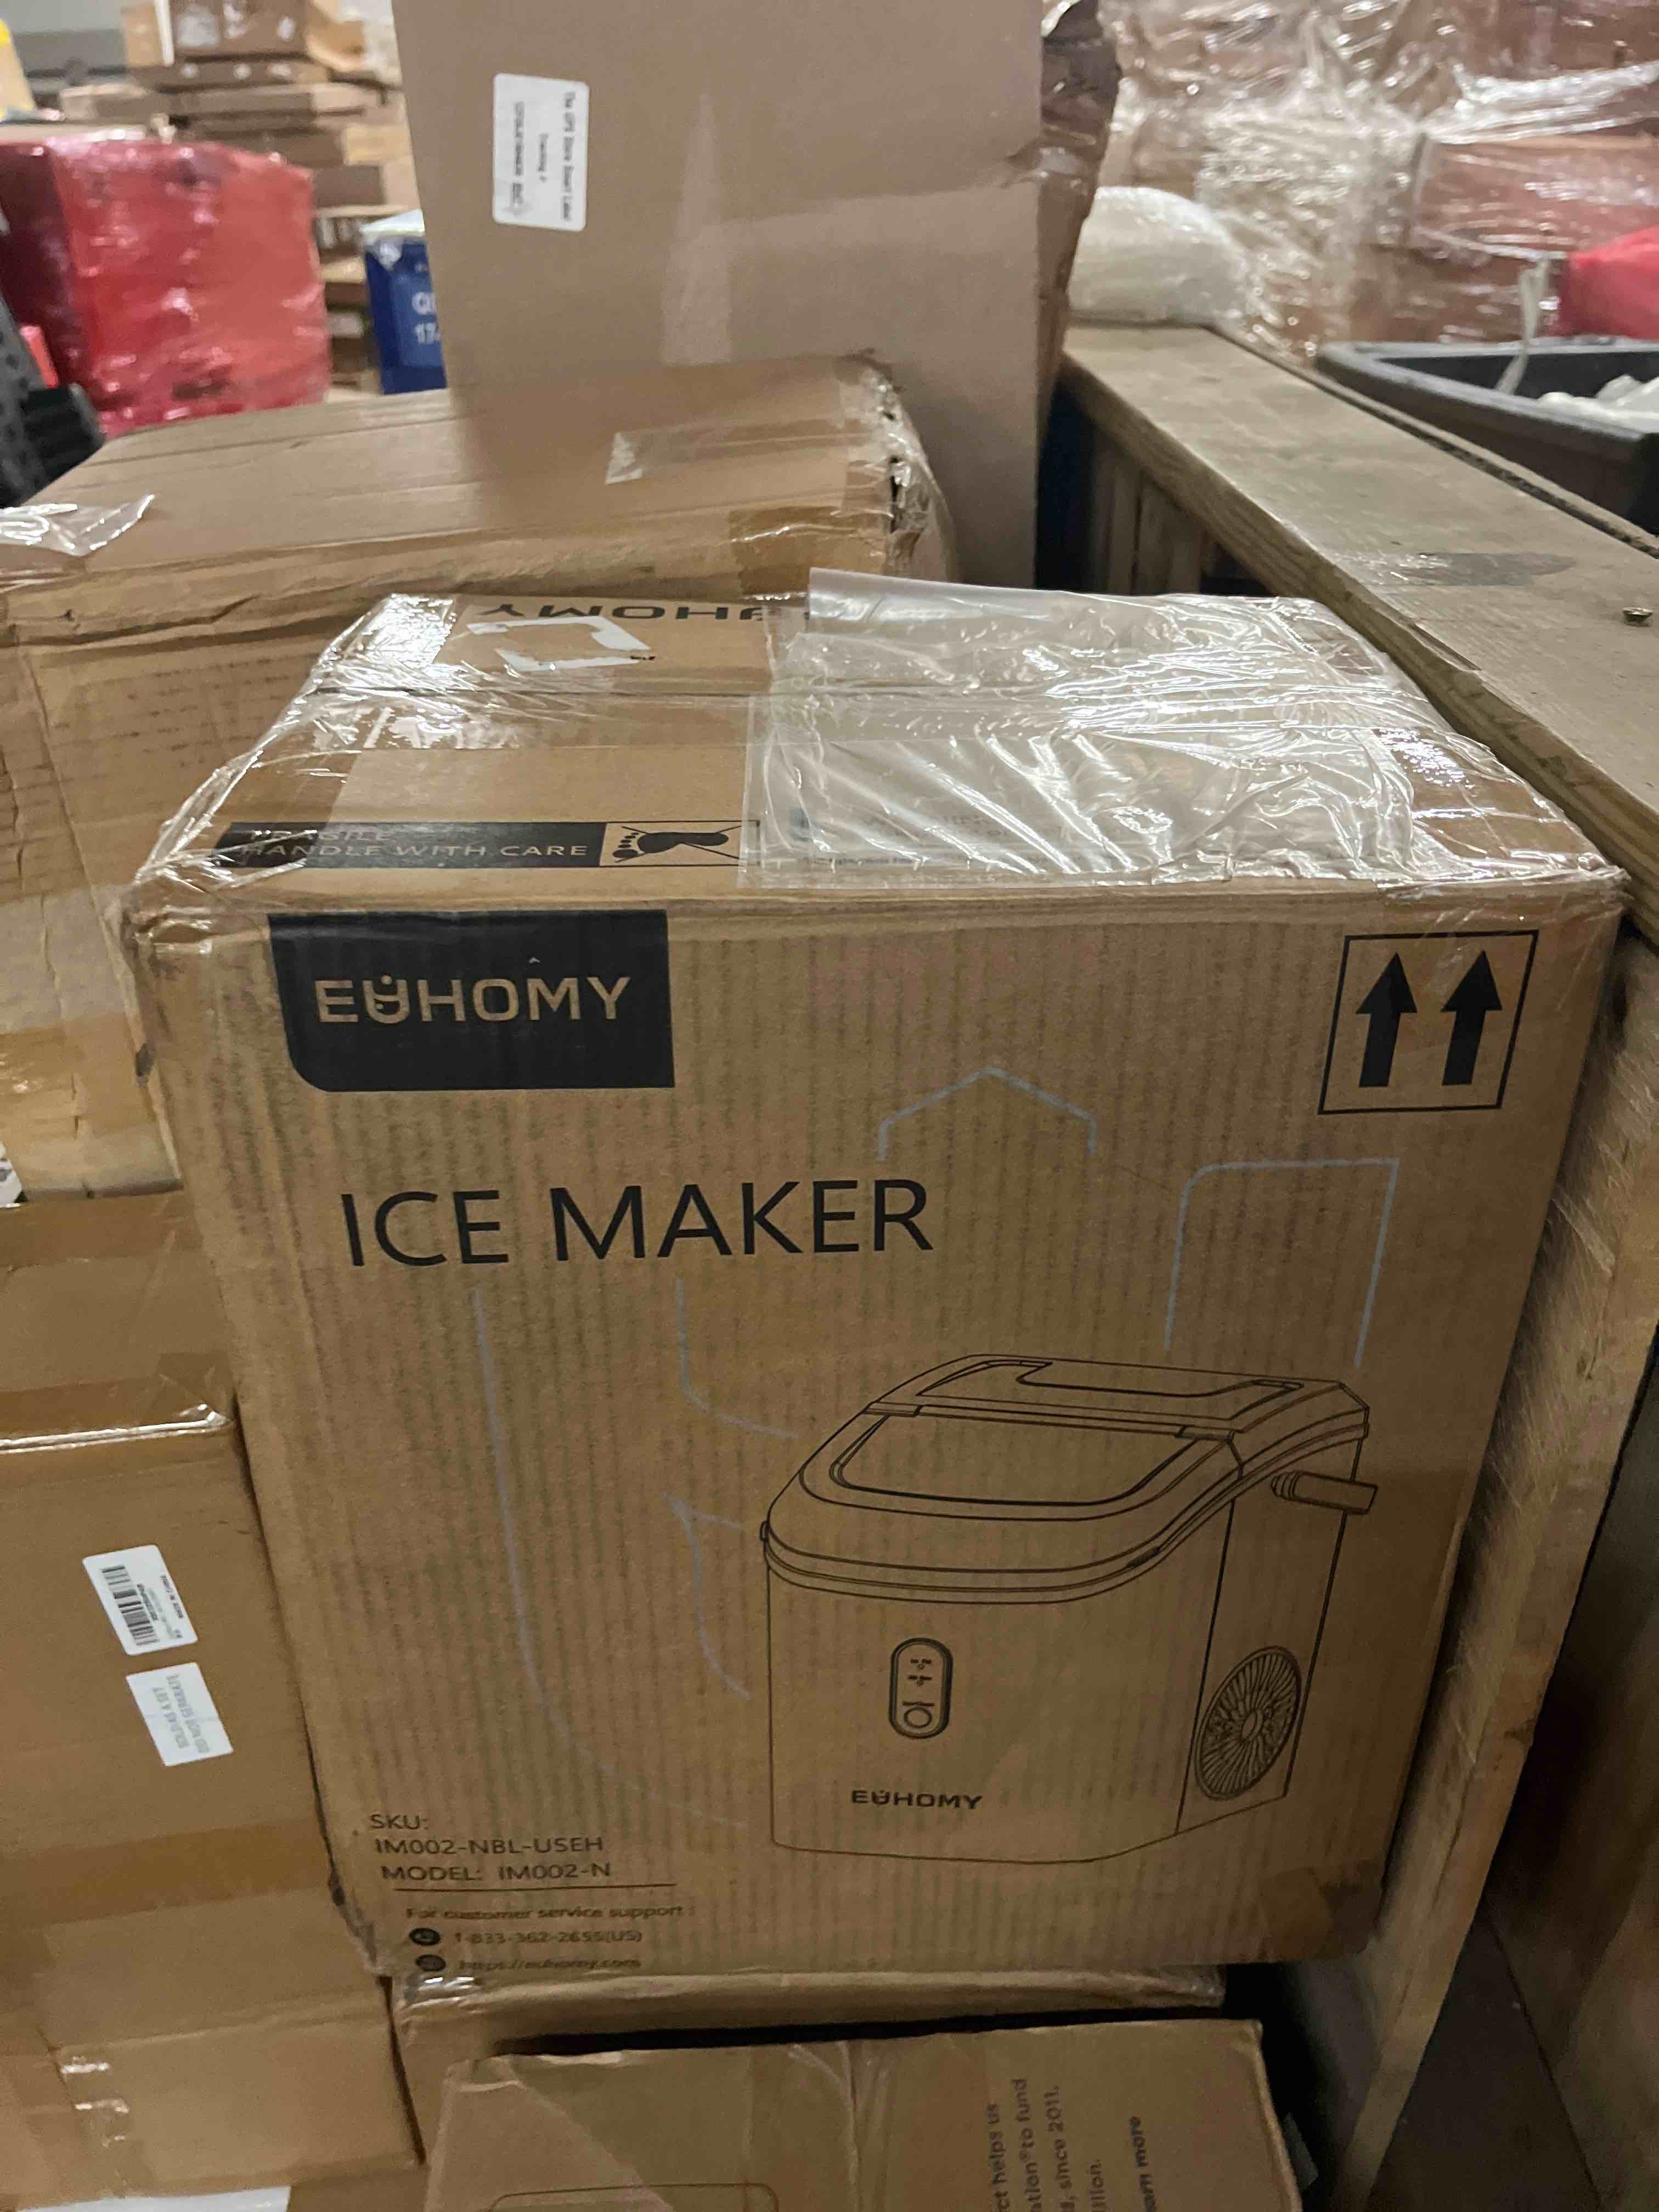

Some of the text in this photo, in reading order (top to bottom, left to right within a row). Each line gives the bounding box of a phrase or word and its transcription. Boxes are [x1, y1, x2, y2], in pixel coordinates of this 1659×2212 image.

[396, 845, 487, 857] WITH
[501, 844, 588, 857] CARE
[315, 975, 631, 1025] EUHOMY
[340, 1178, 934, 1267] ICE MAKER
[851, 1790, 983, 1809] EUHOMY
[370, 1814, 428, 1830] SKU:
[374, 1837, 603, 1855] IM002-NBL-USEH
[381, 1862, 612, 1881] MODEL: IM002-N
[538, 1907, 603, 1919] service
[608, 1905, 684, 1919] support
[987, 2103, 1001, 2124] us
[1012, 2079, 1031, 2123] fund
[1044, 2085, 1064, 2132] 2011.
[989, 2131, 1008, 2185] helps
[1130, 2115, 1149, 2169] more
[1053, 2139, 1073, 2190] since
